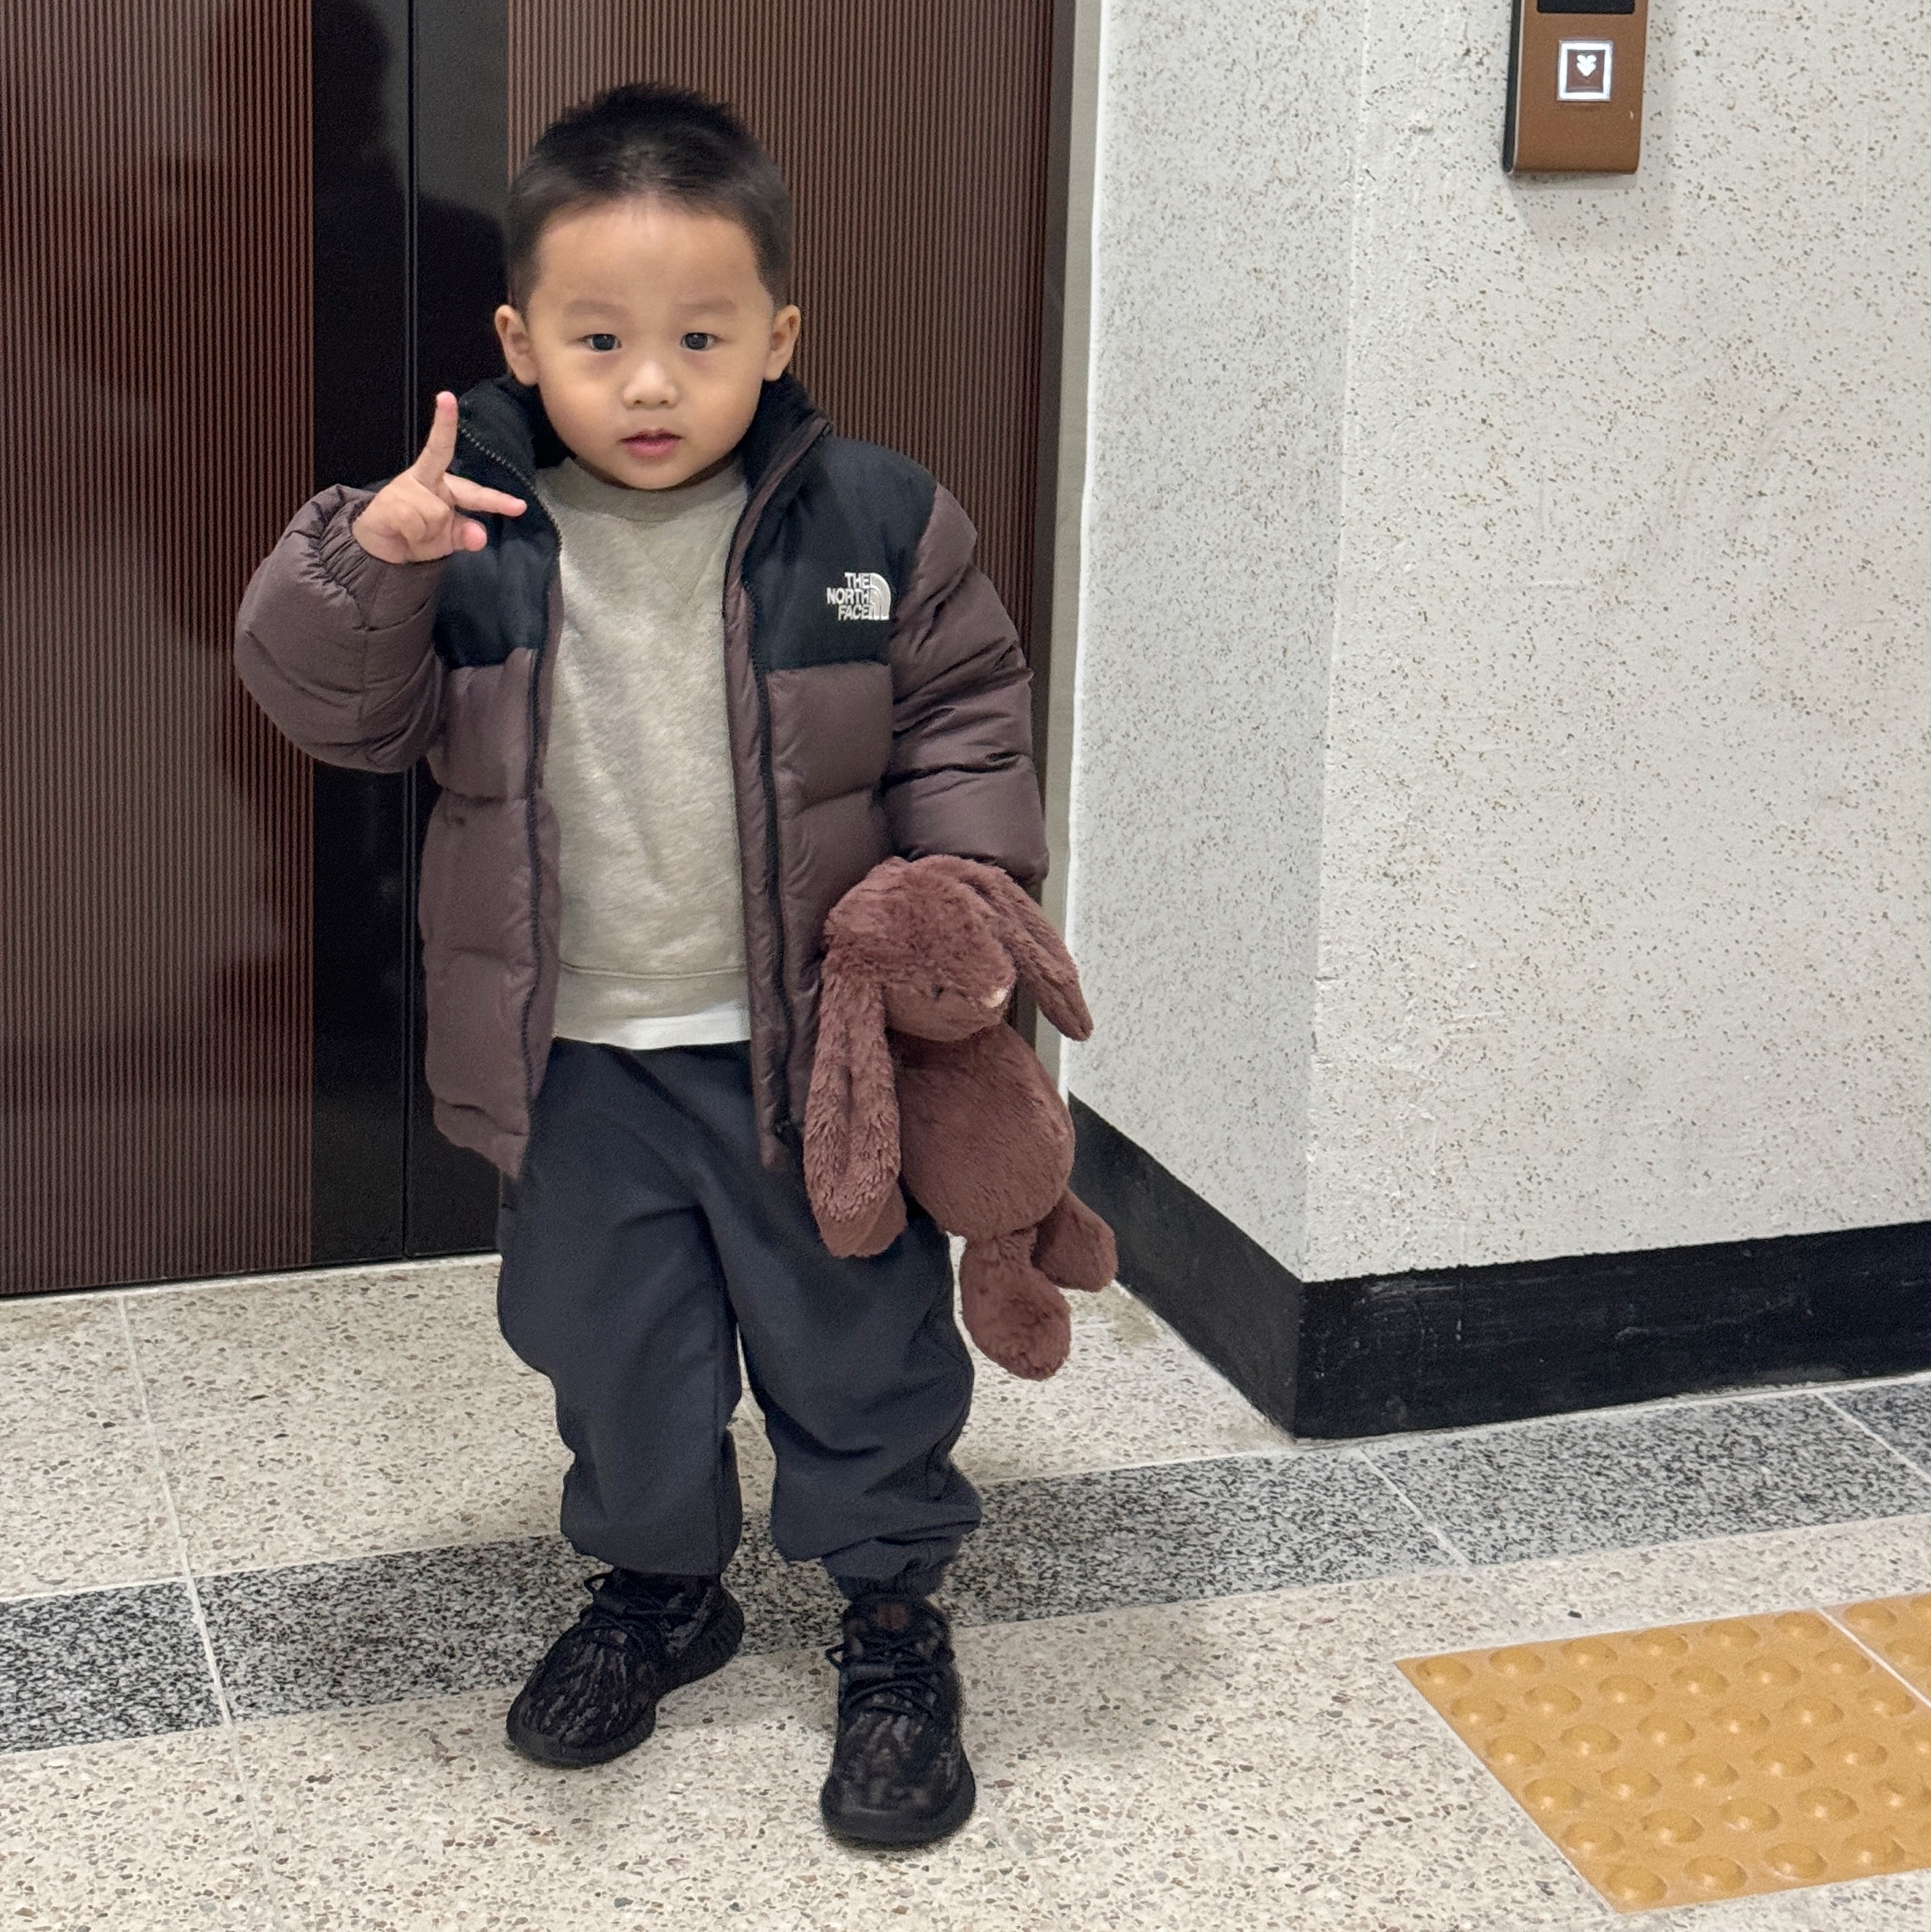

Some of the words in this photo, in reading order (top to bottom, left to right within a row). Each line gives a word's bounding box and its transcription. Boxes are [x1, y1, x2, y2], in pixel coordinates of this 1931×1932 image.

[844, 572, 870, 589] THE
[827, 587, 870, 604] NORTH
[837, 604, 871, 621] FACE
